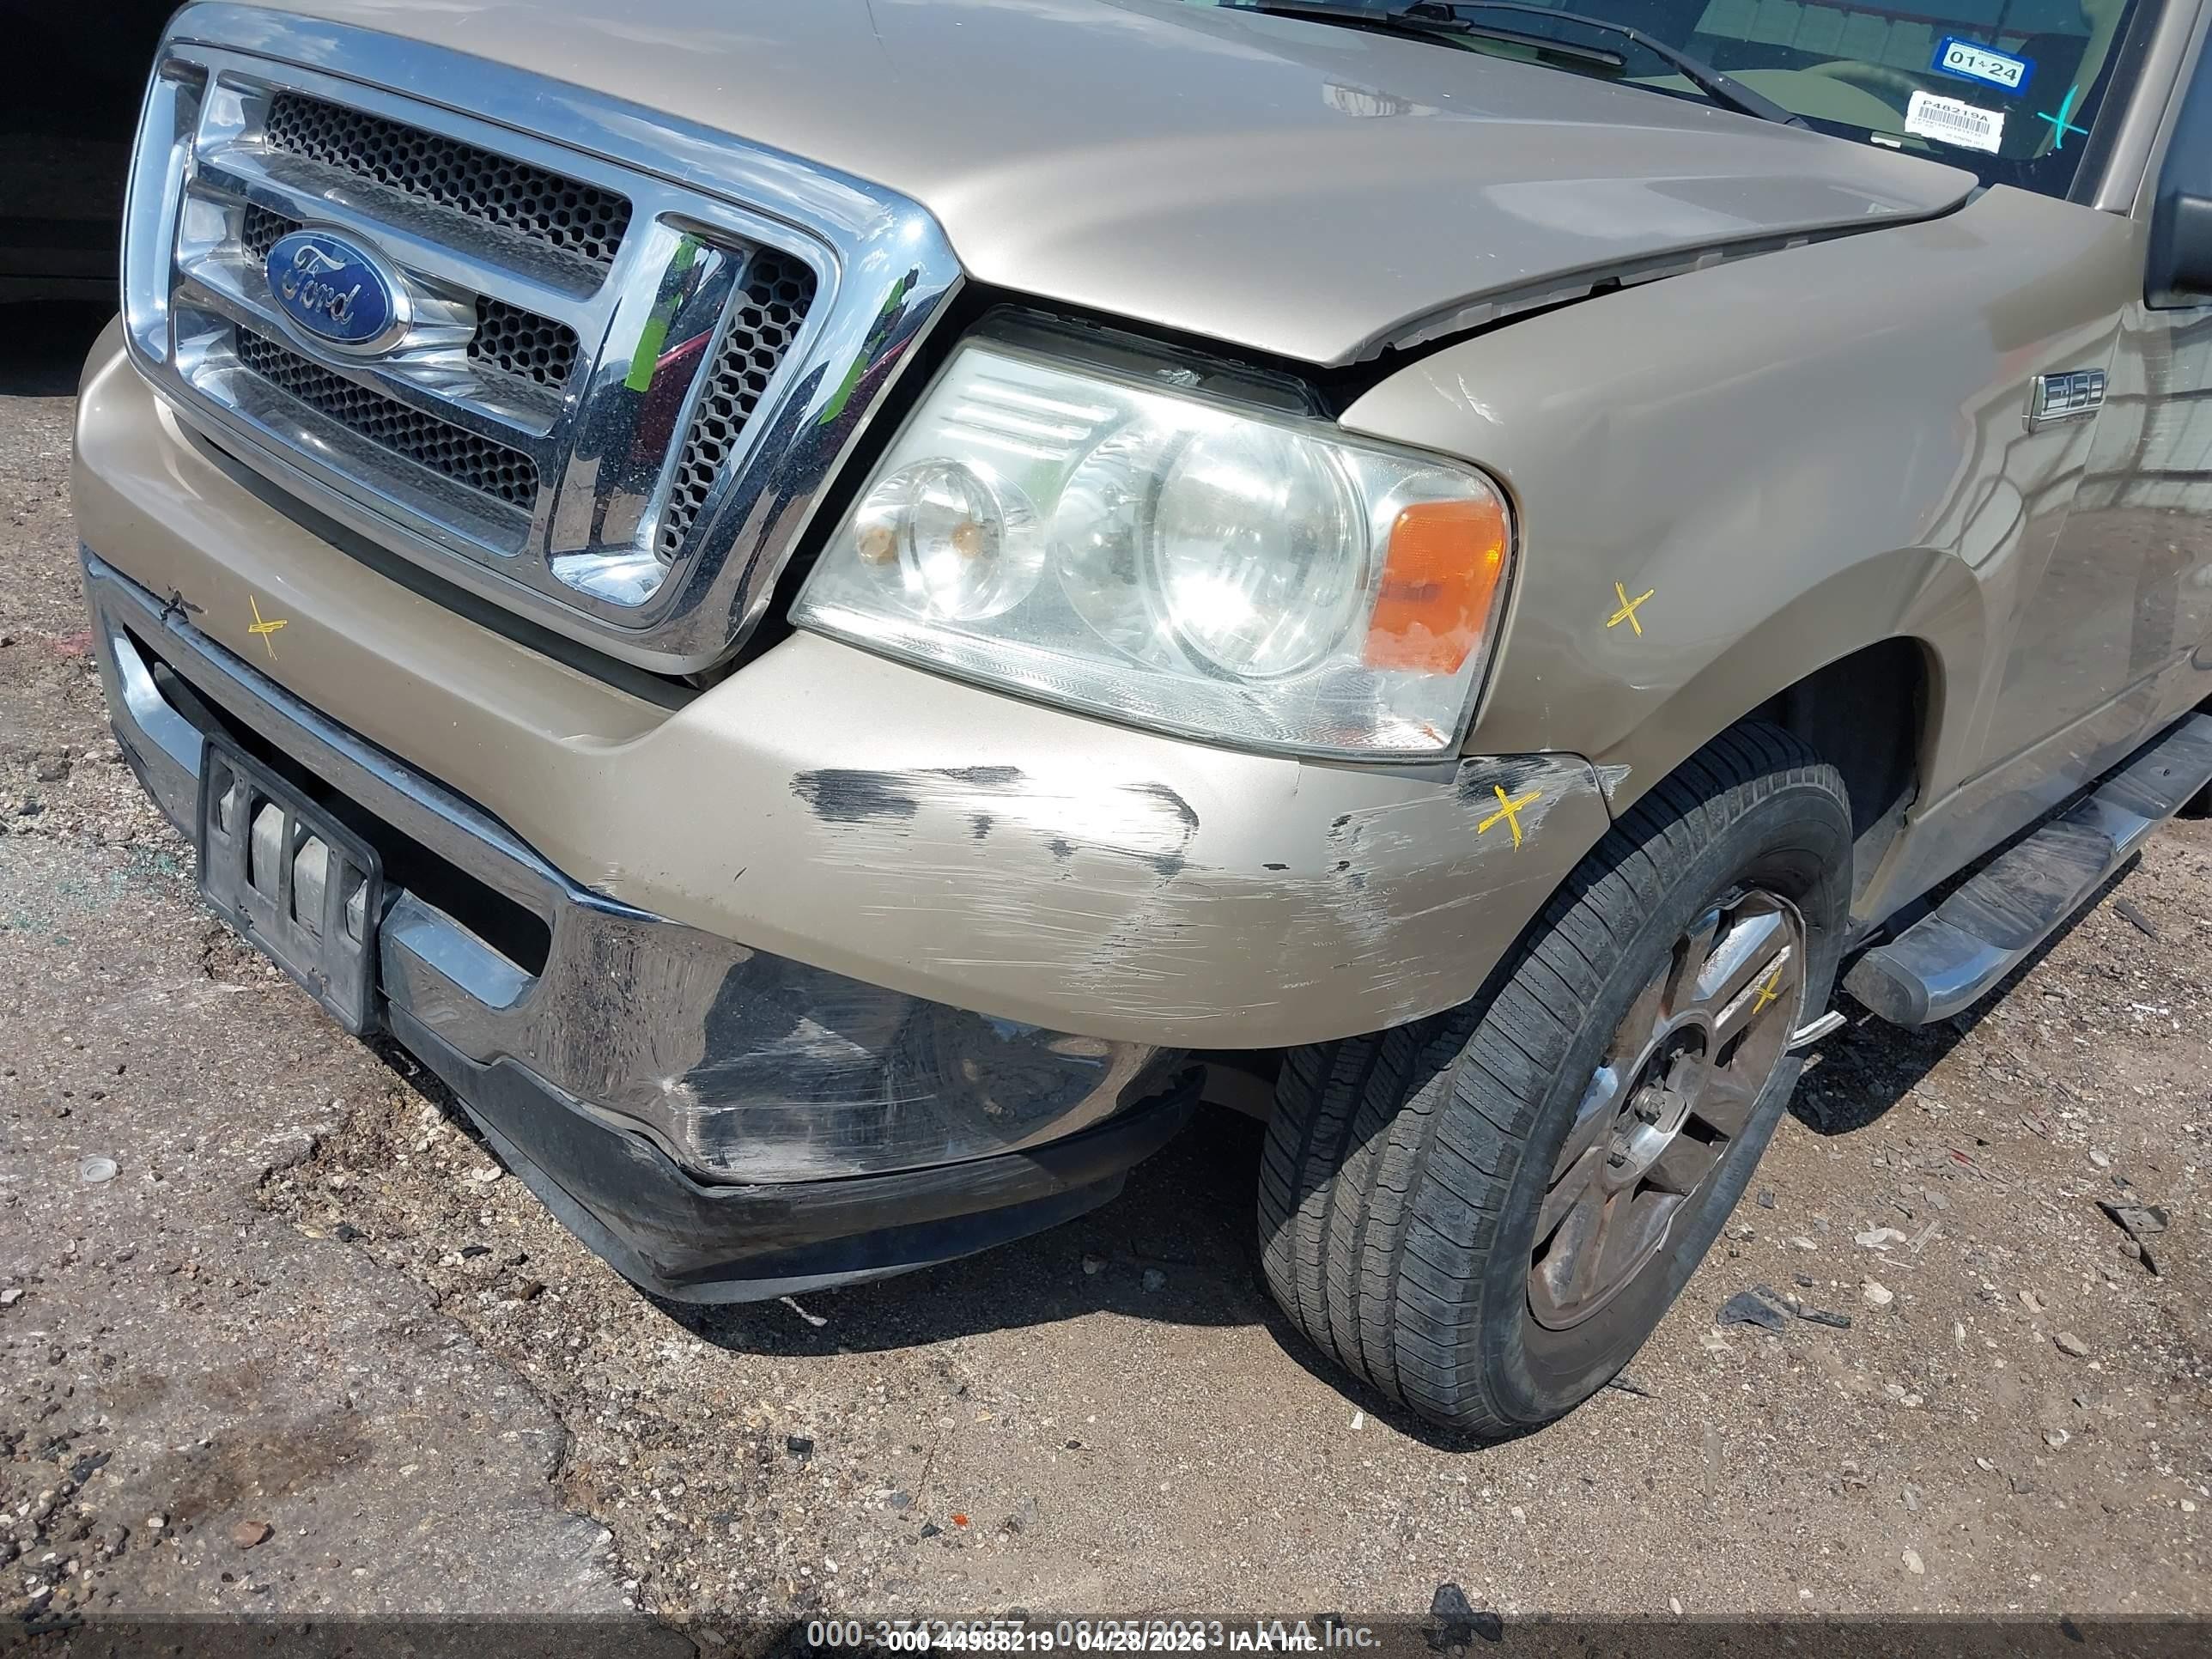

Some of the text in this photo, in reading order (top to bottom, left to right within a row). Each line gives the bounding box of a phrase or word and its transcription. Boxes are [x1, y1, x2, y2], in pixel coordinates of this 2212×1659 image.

[1949, 51, 1975, 68] 01
[1988, 62, 2017, 82] 24
[1923, 100, 1988, 122] P48219A
[282, 245, 362, 325] Ford
